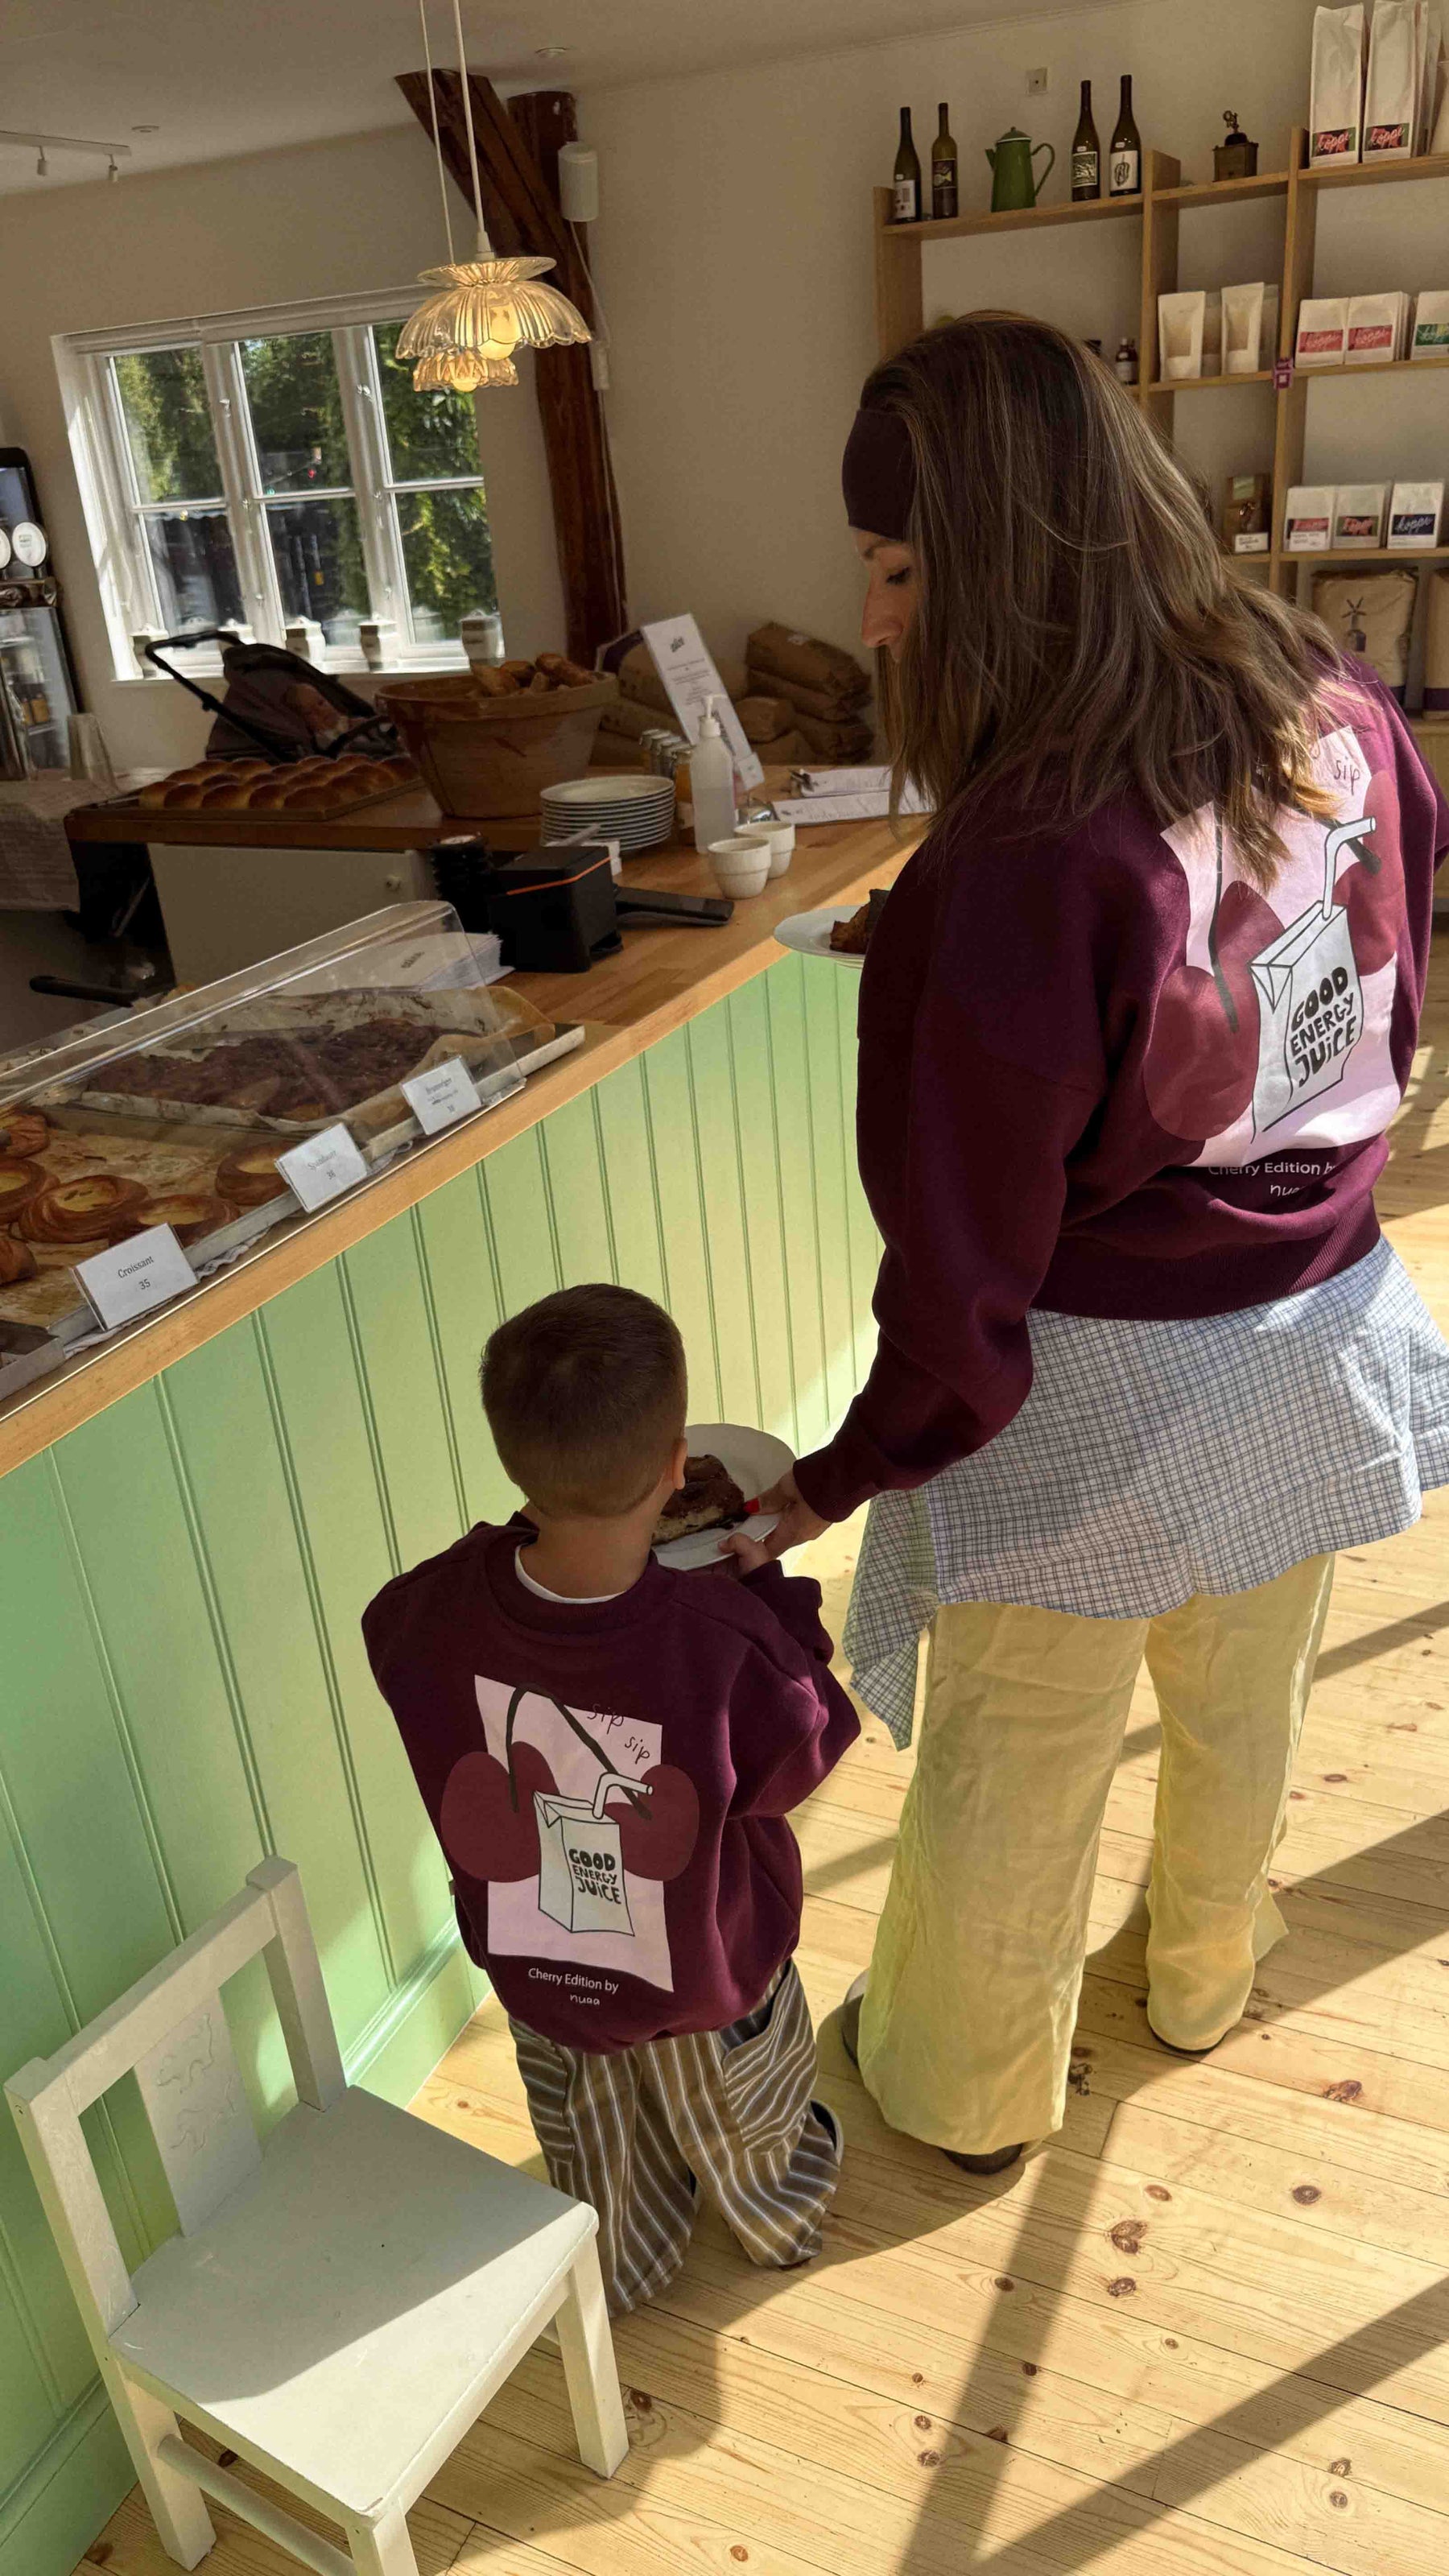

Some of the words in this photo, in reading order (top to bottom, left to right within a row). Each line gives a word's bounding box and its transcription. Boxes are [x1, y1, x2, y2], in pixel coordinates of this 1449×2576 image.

[1334, 756, 1360, 796] sip
[1291, 967, 1348, 1031] GOOD
[1290, 992, 1354, 1057] ENERGY
[1265, 1162, 1321, 1175] Edition
[118, 1256, 155, 1278] Croissant
[138, 1278, 151, 1290] 35
[587, 1703, 624, 1735] sip
[625, 1736, 650, 1765] sip
[568, 1848, 616, 1872] GOOD
[572, 1864, 617, 1885] ENERGY
[528, 1967, 563, 1985] Cherry
[564, 1973, 602, 1990] Edition
[604, 1979, 619, 1995] by
